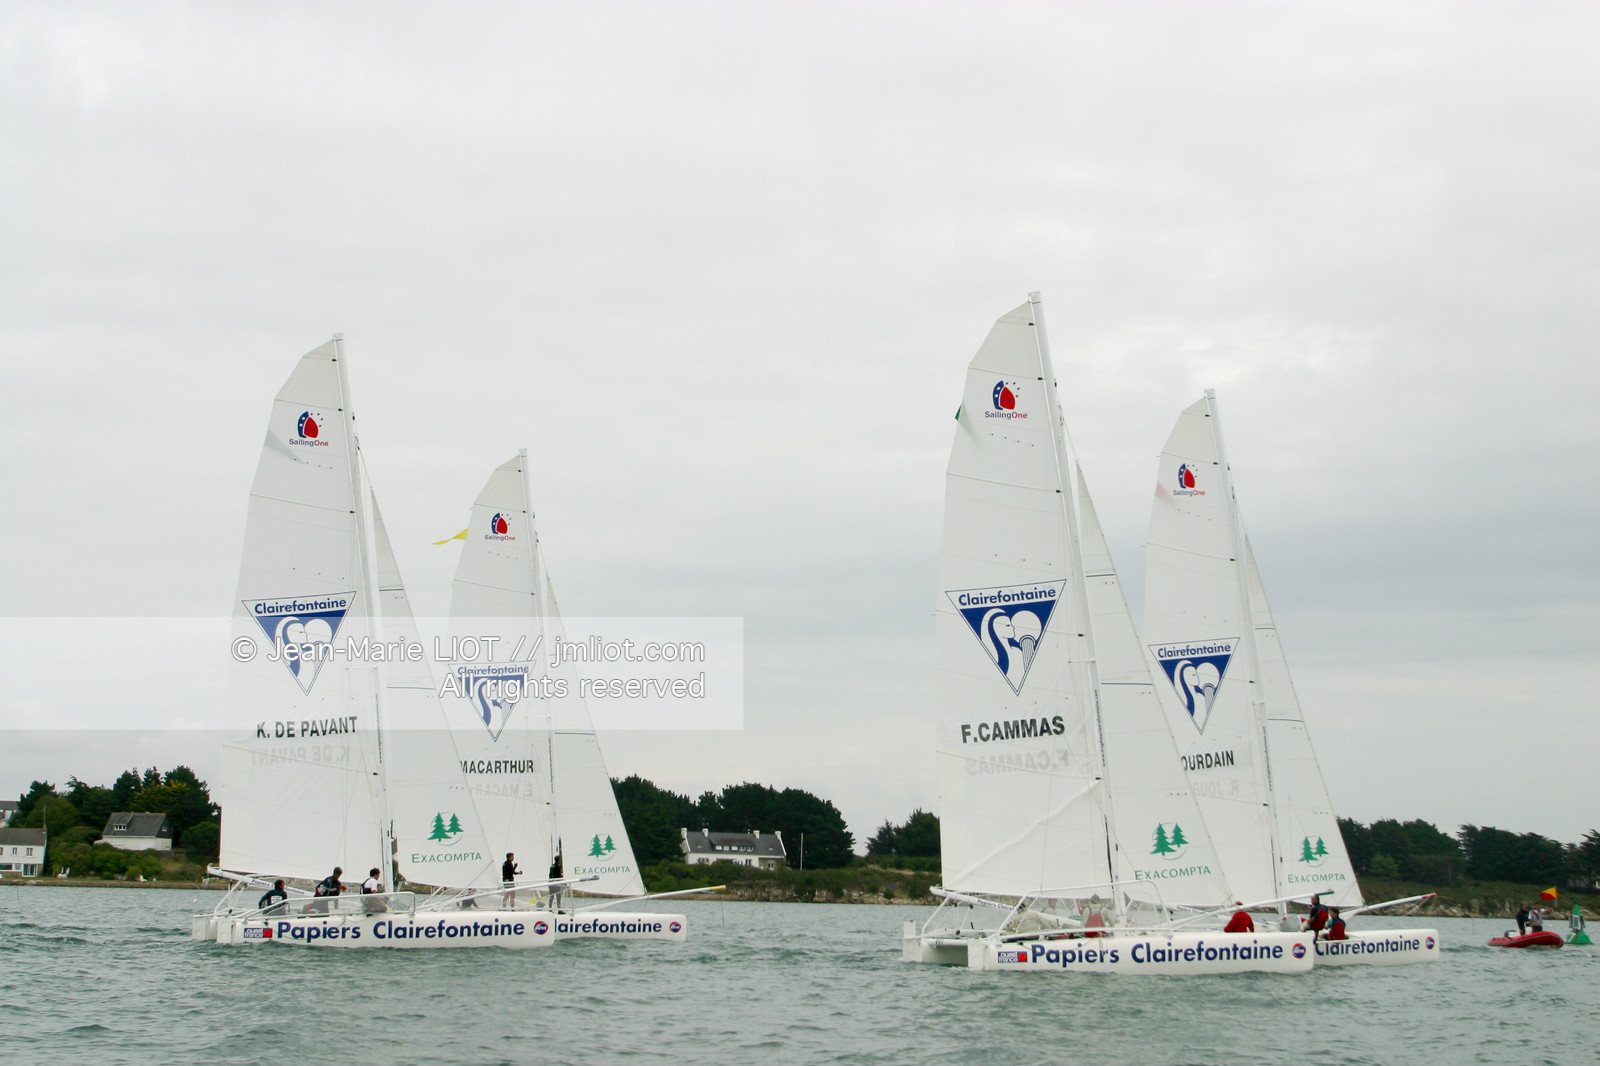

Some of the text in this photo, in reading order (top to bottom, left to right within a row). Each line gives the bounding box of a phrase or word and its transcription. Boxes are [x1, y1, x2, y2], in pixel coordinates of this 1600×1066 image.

[984, 411, 1028, 420] SailingOne
[288, 438, 329, 447] SailingOne
[1173, 489, 1205, 497] SailingOne
[958, 587, 1056, 606] Clairefontaine
[254, 598, 347, 614] Clairefontaine
[1157, 643, 1231, 658] Clairefontaine
[457, 665, 529, 675] Clairefontaine
[256, 716, 358, 738] K. DE PAVANT
[961, 715, 1066, 743] F.CAMMAS
[460, 760, 534, 774] MACARTHUR
[1181, 750, 1235, 771] OURDAIN
[411, 852, 482, 864] EXACOMPTA
[574, 866, 631, 875] EXACOMPTA
[1134, 865, 1211, 880] EXACOMPTA
[1287, 872, 1346, 884] EXACOMPTA
[277, 918, 525, 943] Papiers Clairefontaine
[554, 918, 662, 933] lairefontaine
[1031, 939, 1283, 968] Papiers Clairefontaine
